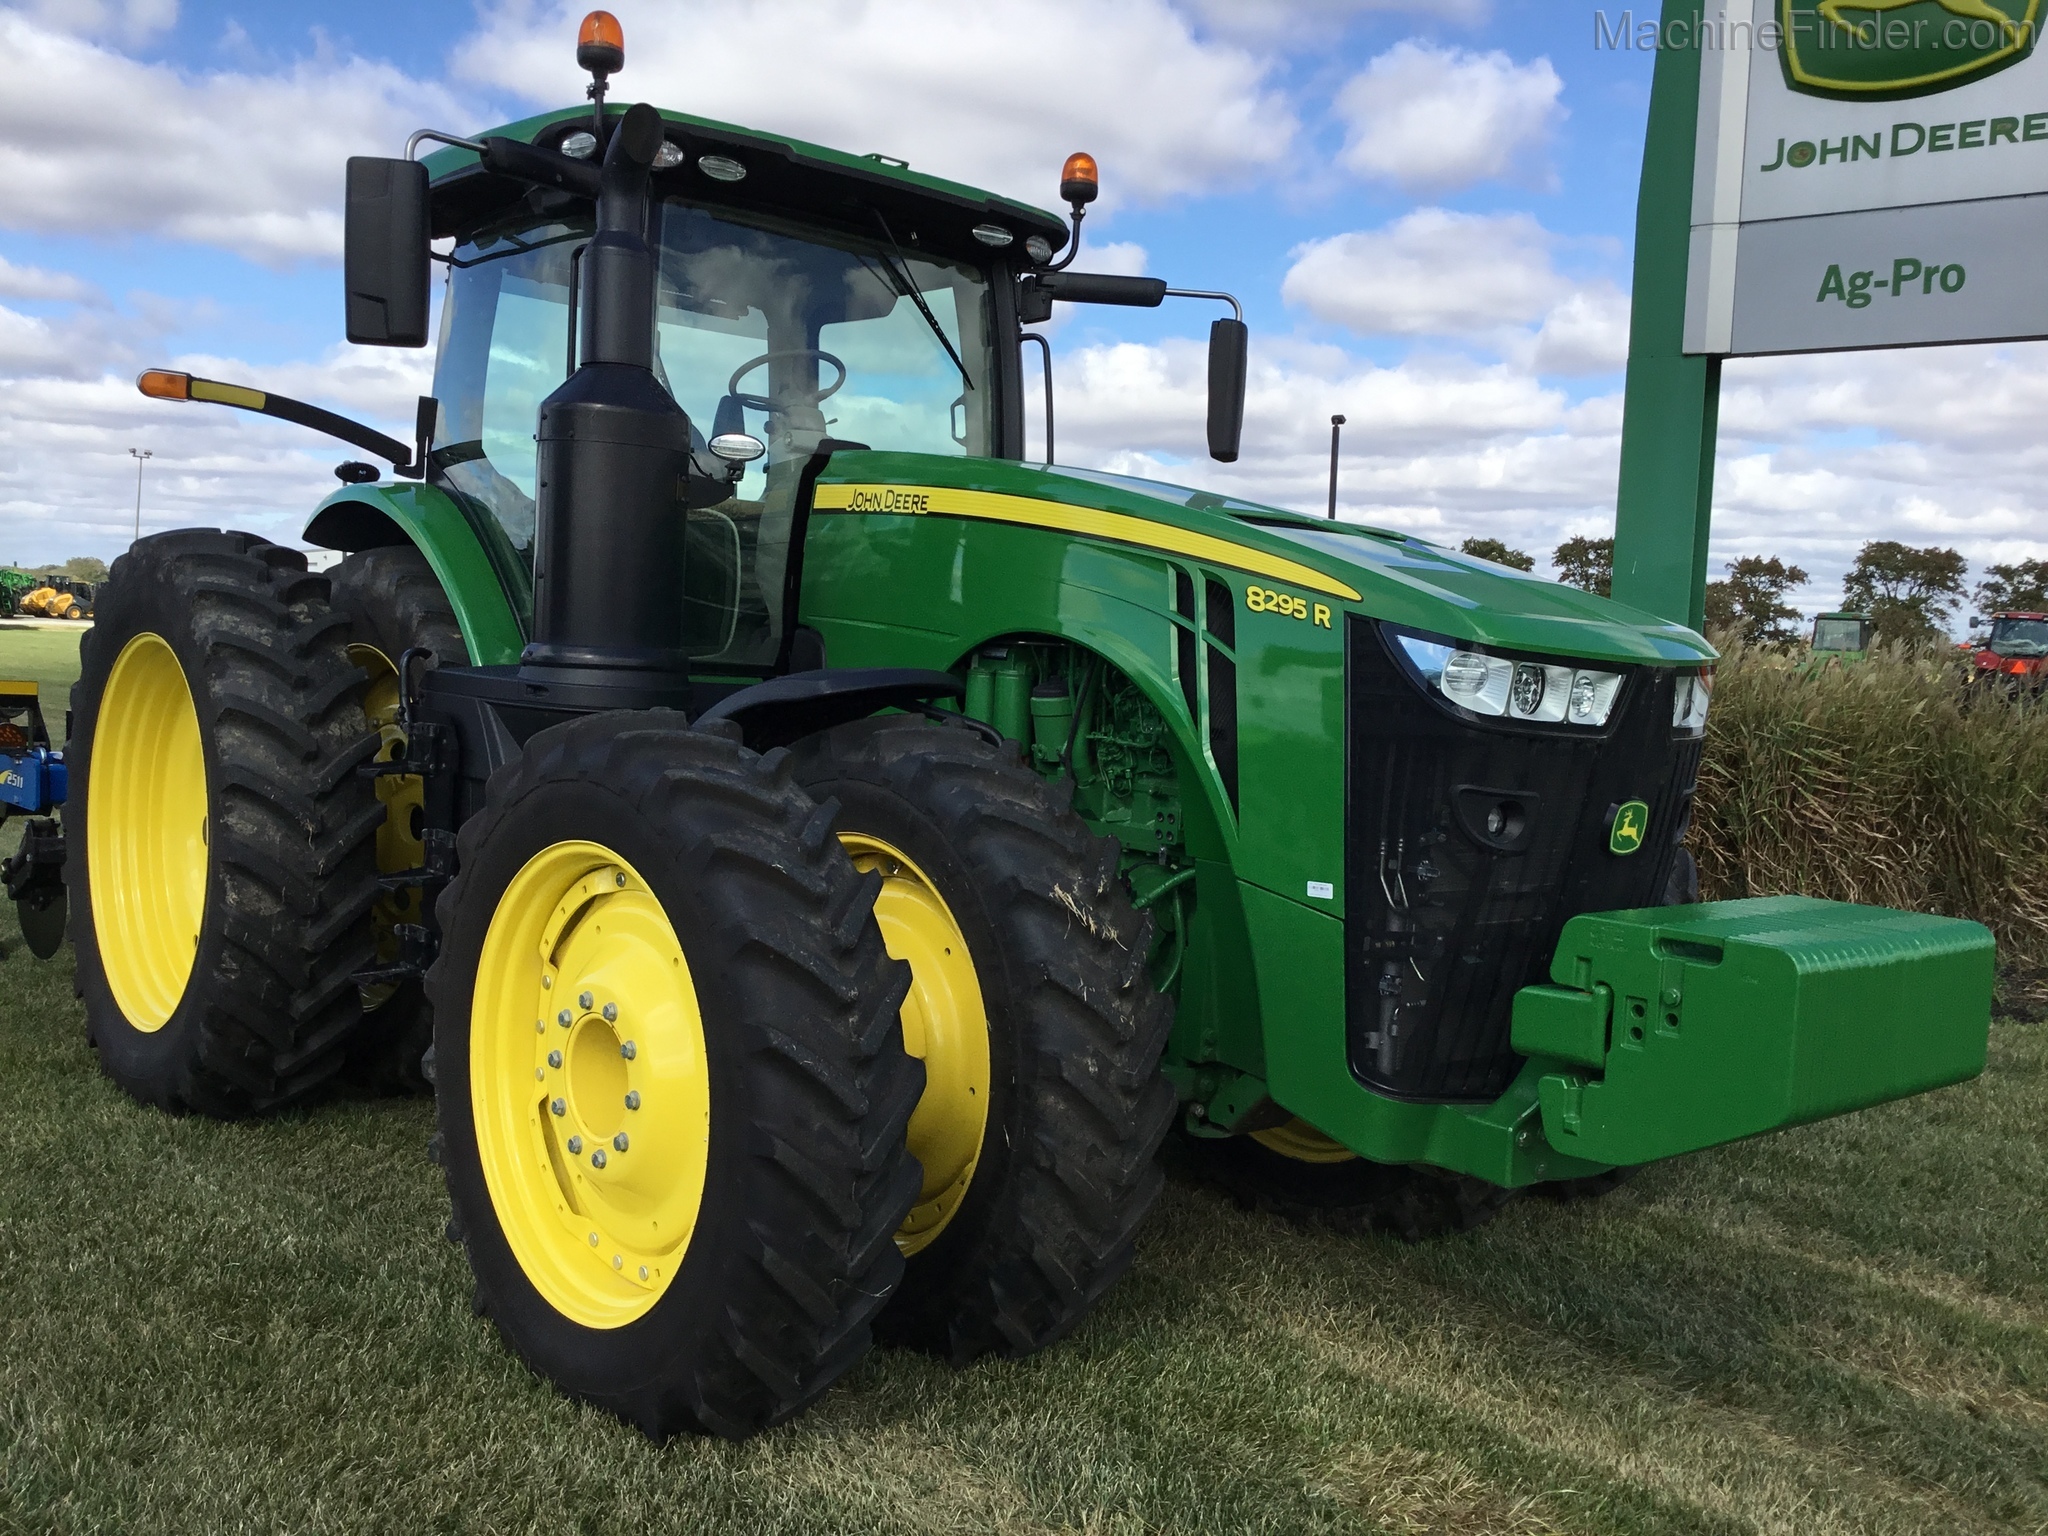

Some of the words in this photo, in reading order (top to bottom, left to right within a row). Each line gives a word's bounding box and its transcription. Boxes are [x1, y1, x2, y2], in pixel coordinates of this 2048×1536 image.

[1760, 132, 1882, 172] JOHN
[1890, 112, 2048, 157] DEERE
[1816, 257, 1966, 309] Ag-Pro
[847, 488, 883, 509] JOHN
[884, 489, 930, 512] DEERE
[1245, 584, 1308, 620] 8295
[1313, 602, 1332, 630] R
[7, 772, 24, 789] 2511
